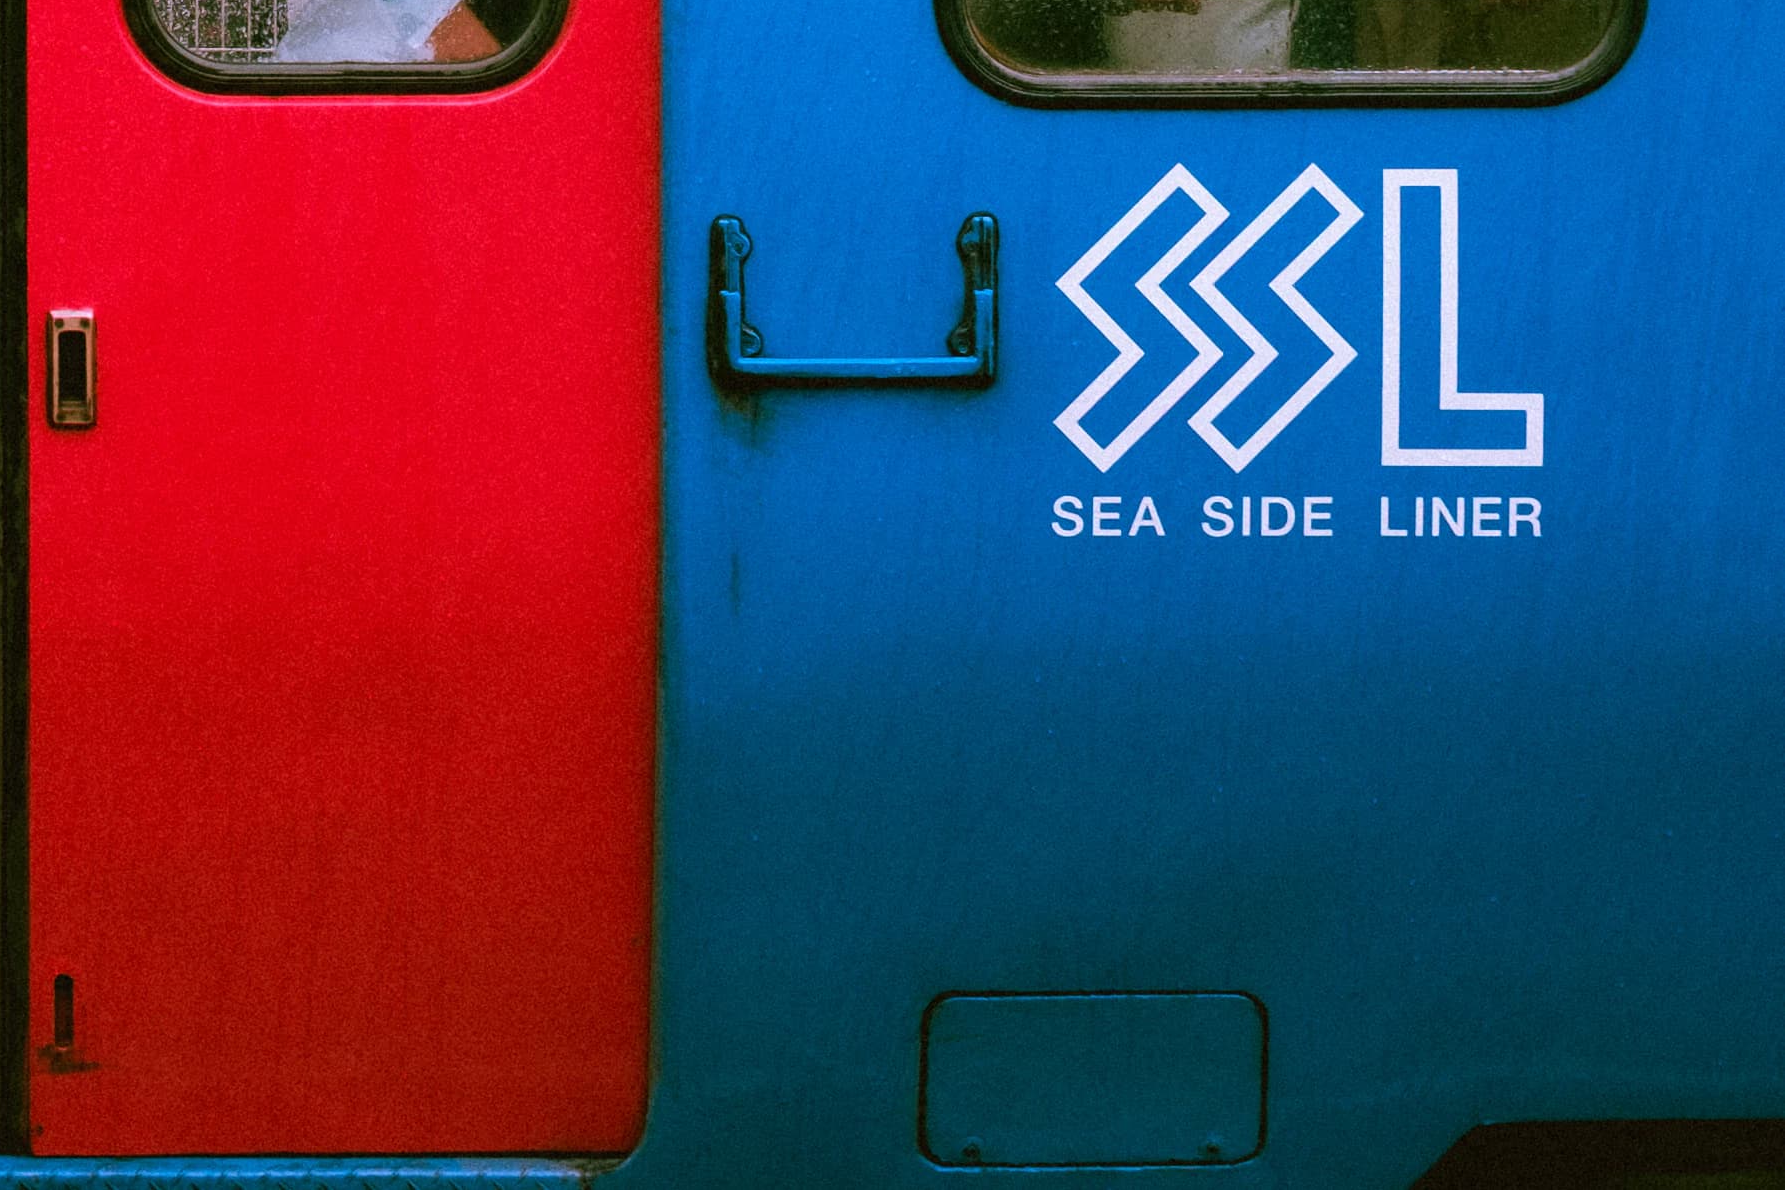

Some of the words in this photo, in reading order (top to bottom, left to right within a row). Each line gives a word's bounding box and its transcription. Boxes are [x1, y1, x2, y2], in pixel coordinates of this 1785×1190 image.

[1053, 162, 1544, 473] SSL
[1051, 495, 1165, 537] SEA
[1201, 495, 1333, 537] SIDE
[1380, 496, 1542, 537] LINER
